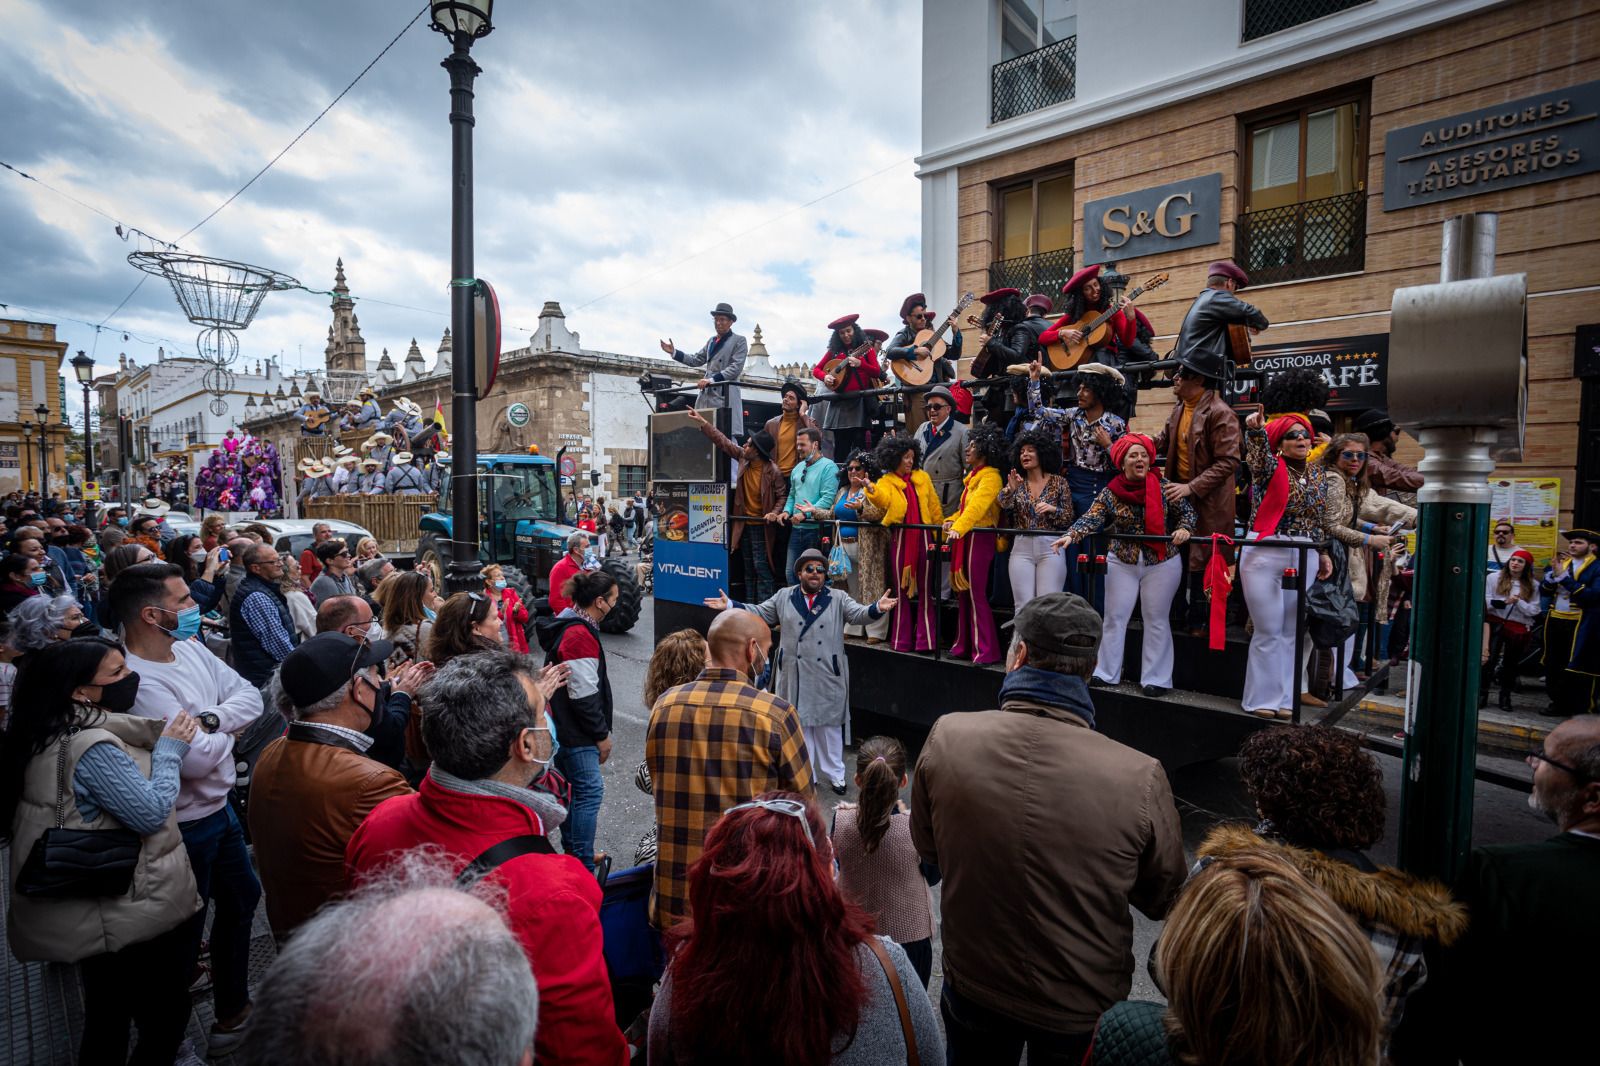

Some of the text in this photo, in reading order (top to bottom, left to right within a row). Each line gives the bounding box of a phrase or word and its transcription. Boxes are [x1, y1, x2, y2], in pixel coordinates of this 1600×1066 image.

[1419, 98, 1571, 147] AUDITORES
[1407, 148, 1582, 196] TRIBUTARIOS
[1424, 134, 1561, 177] ASESORES
[1101, 190, 1199, 250] S&G
[1254, 353, 1332, 371] GASTROBAR
[1308, 359, 1381, 388] AFÉ
[692, 504, 723, 512] MURPROTEC
[657, 562, 722, 580] VITALDENT
